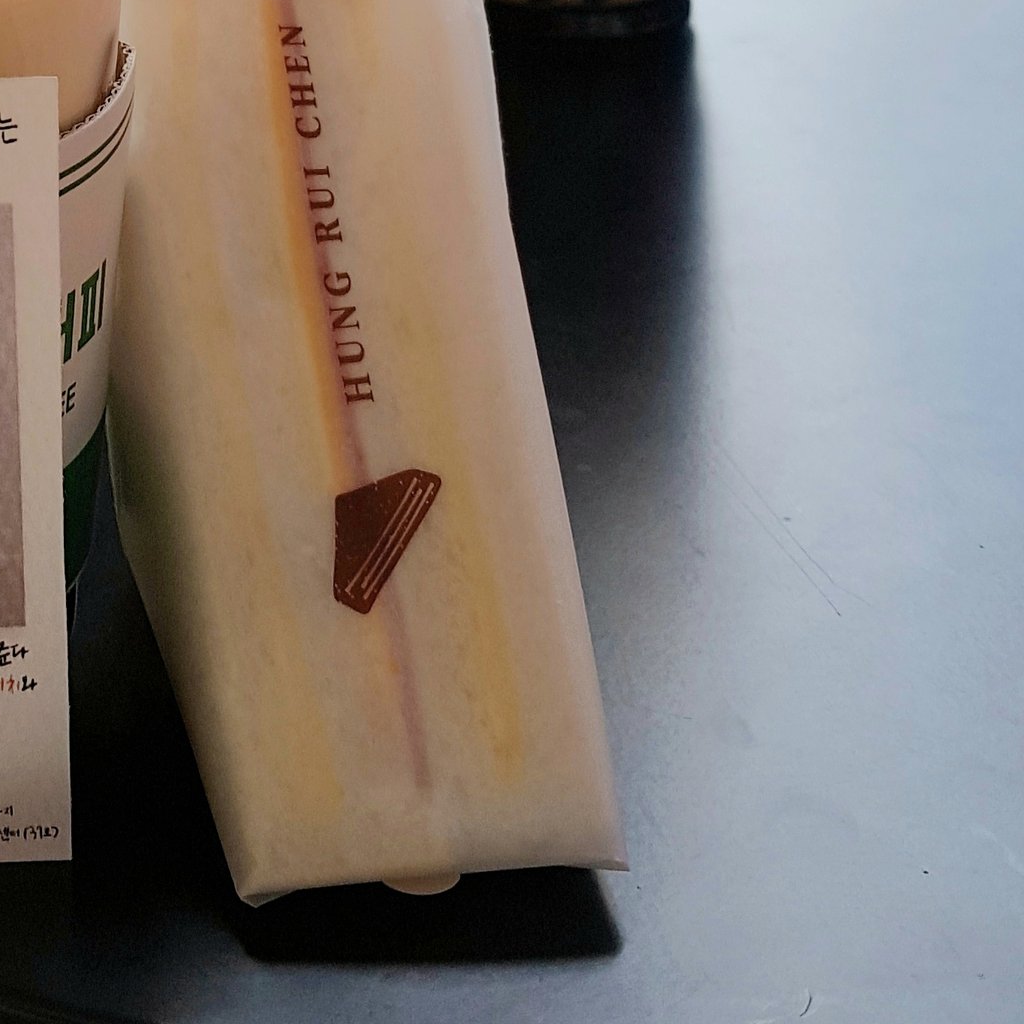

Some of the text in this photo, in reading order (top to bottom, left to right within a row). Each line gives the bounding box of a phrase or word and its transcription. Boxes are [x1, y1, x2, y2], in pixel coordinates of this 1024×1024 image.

[278, 24, 375, 406] HUNG RUI CHEN
